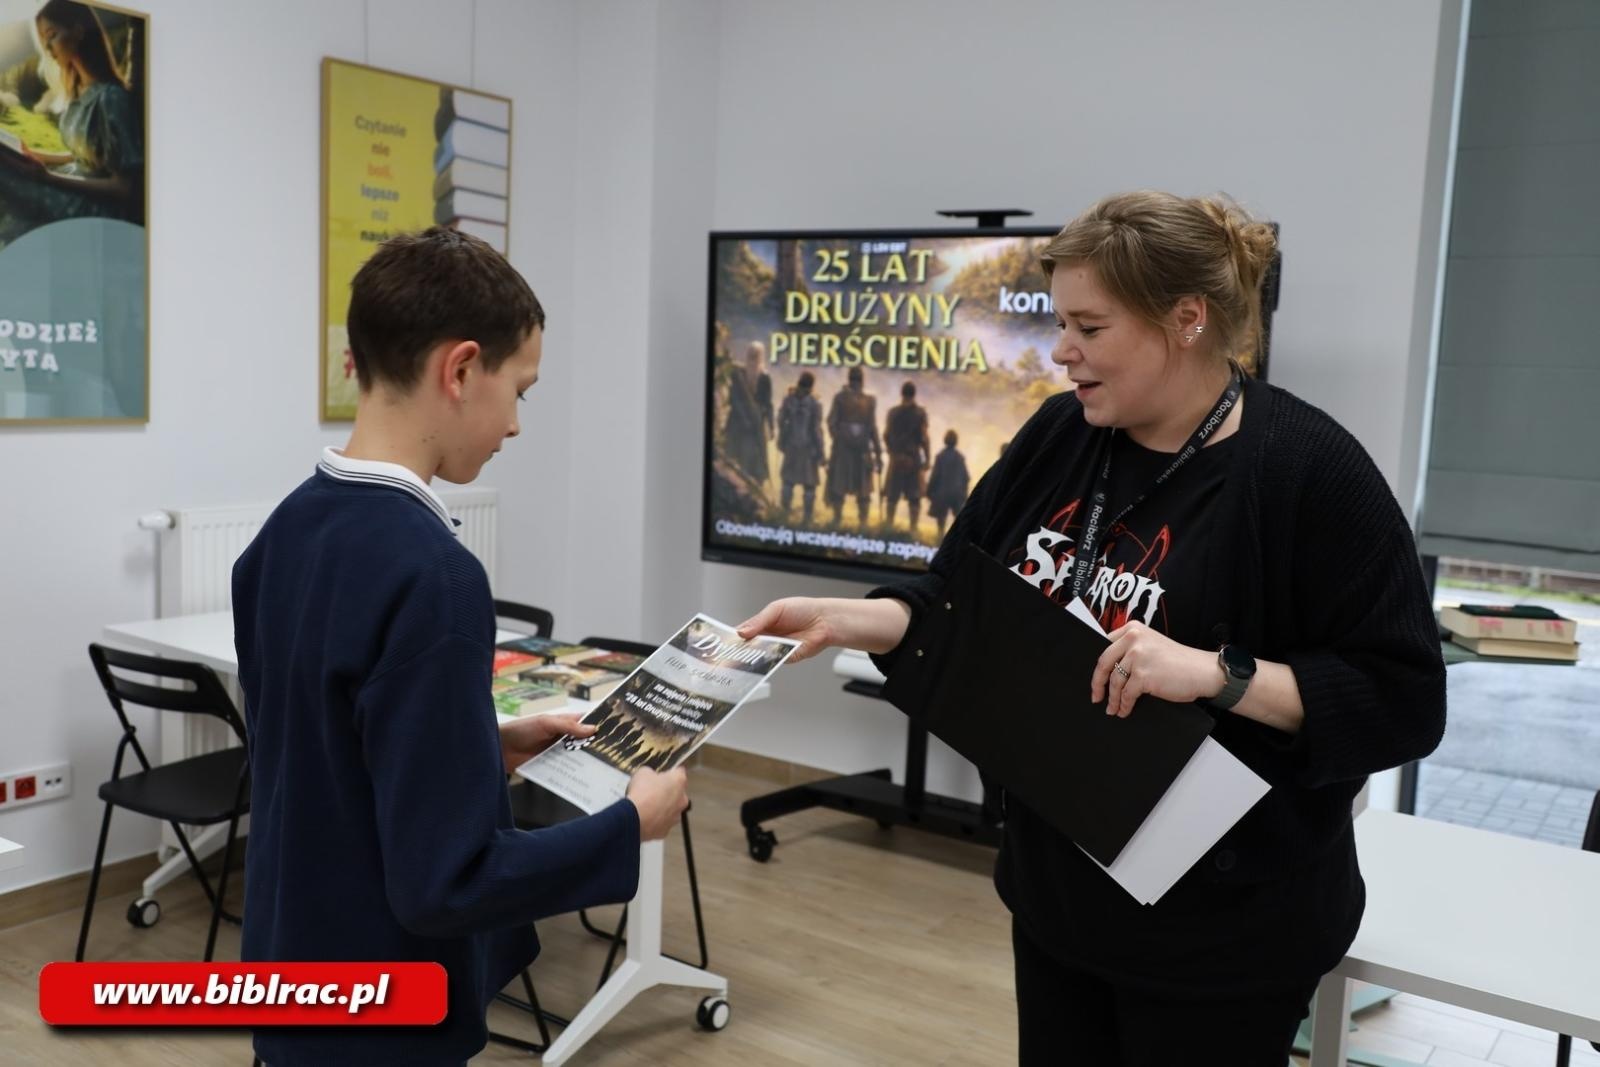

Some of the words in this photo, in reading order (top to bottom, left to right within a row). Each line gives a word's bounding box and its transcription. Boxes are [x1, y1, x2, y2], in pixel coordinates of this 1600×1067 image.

[354, 115, 407, 138] Czytanie
[371, 142, 390, 157] nie
[360, 184, 400, 202] lepsze
[813, 250, 849, 282] 25
[859, 249, 933, 283] LAT
[785, 288, 960, 328] DRUŻYNY
[999, 286, 1055, 314] kon
[769, 328, 988, 372] PIERŚCIENIA
[1198, 398, 1233, 440] Racibórz
[1155, 444, 1197, 484] Biblioteka
[715, 519, 793, 545] Obowiązują
[795, 530, 886, 555] wcześniejsze
[1083, 504, 1104, 551] Racibórz
[691, 633, 766, 666] Dyplom
